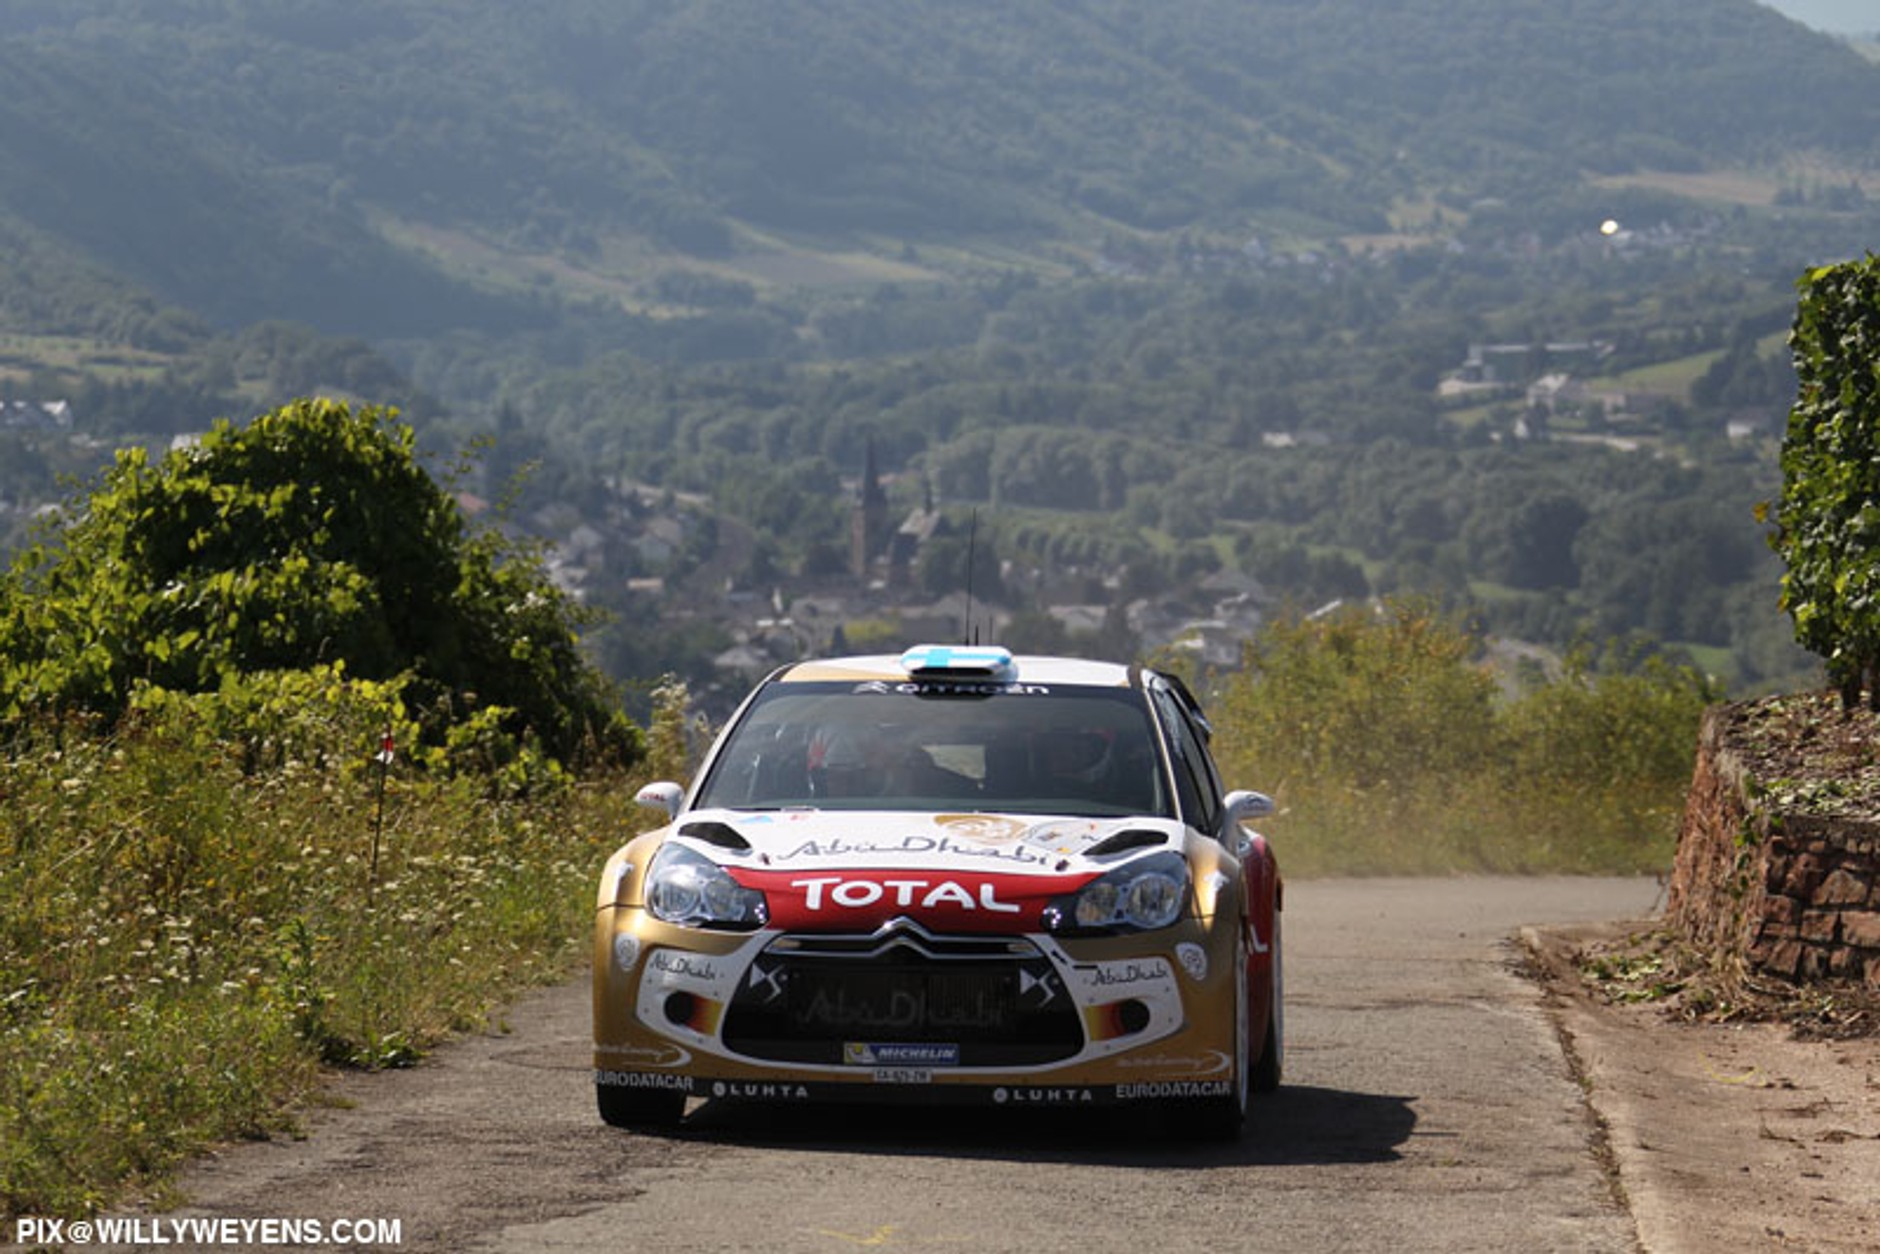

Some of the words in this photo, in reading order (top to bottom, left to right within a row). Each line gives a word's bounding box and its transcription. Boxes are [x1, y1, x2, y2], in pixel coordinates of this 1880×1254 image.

[791, 877, 1020, 913] TOTAL
[878, 1046, 956, 1059] MICHELIN
[730, 1082, 808, 1098] LUHTA
[1013, 1087, 1092, 1101] LUHTA
[1115, 1081, 1231, 1098] EURODATACAR
